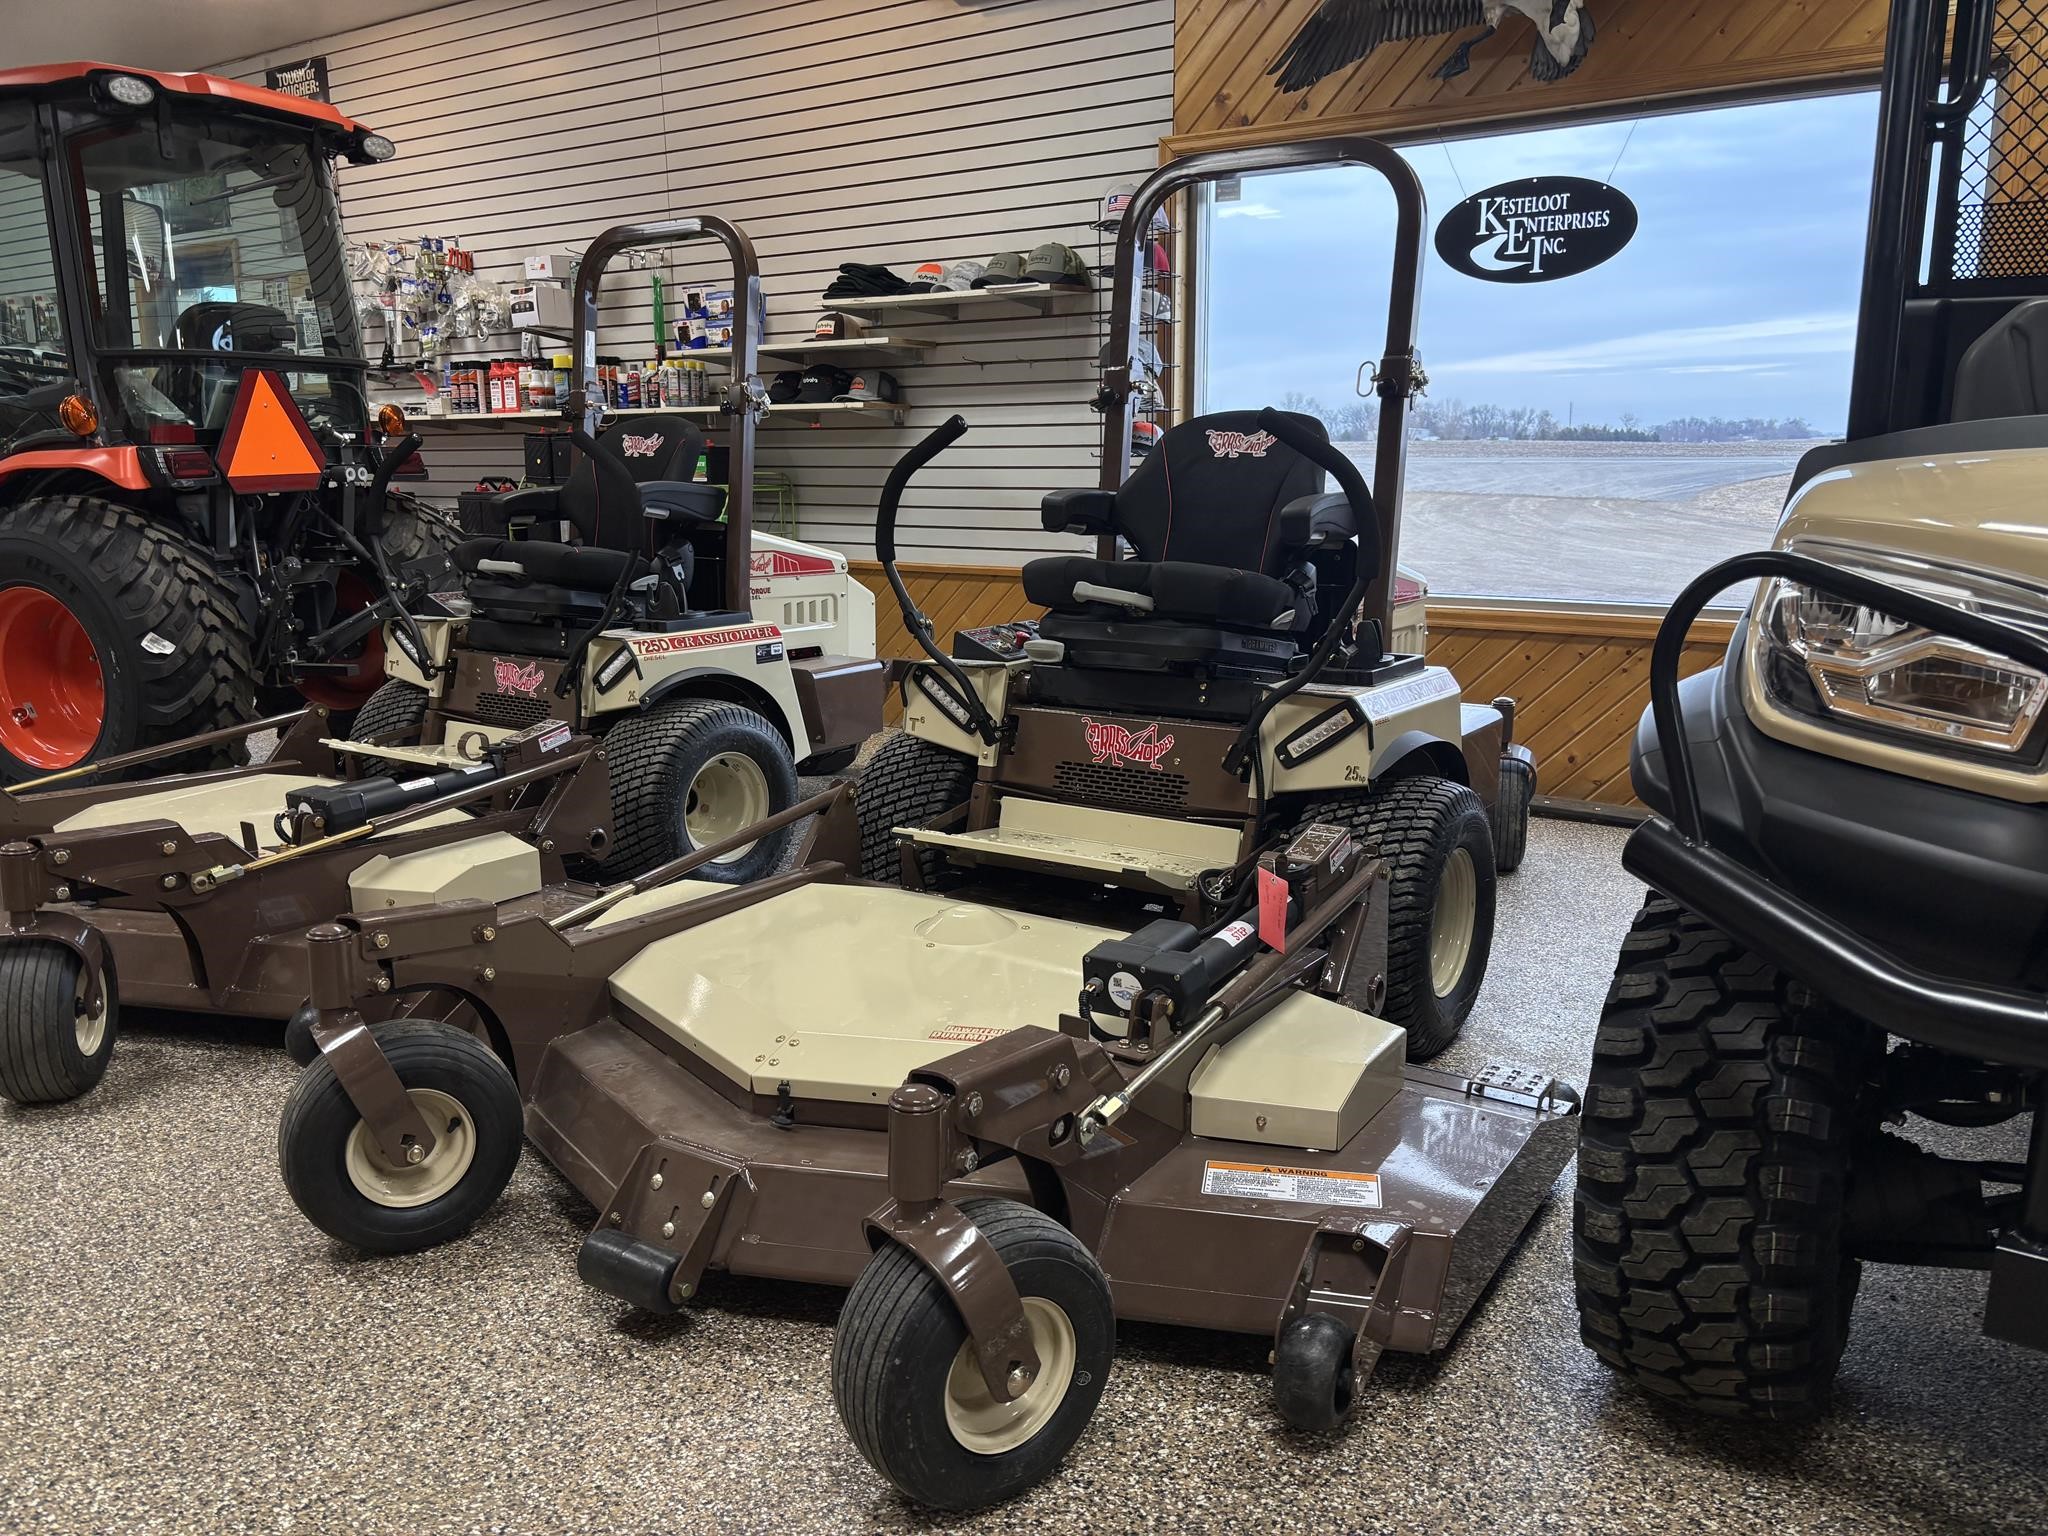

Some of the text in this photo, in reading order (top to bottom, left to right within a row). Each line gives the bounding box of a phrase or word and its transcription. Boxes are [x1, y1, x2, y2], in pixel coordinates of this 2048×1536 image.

[276, 67, 316, 88] TOUGH or
[1503, 210, 1611, 255] ENTERPRISES
[633, 626, 774, 654] 725D GRASSHOPPER
[1081, 717, 1175, 770] GRASSHOPPER
[1231, 926, 1248, 941] STEP
[1278, 1167, 1329, 1178] WARNING
